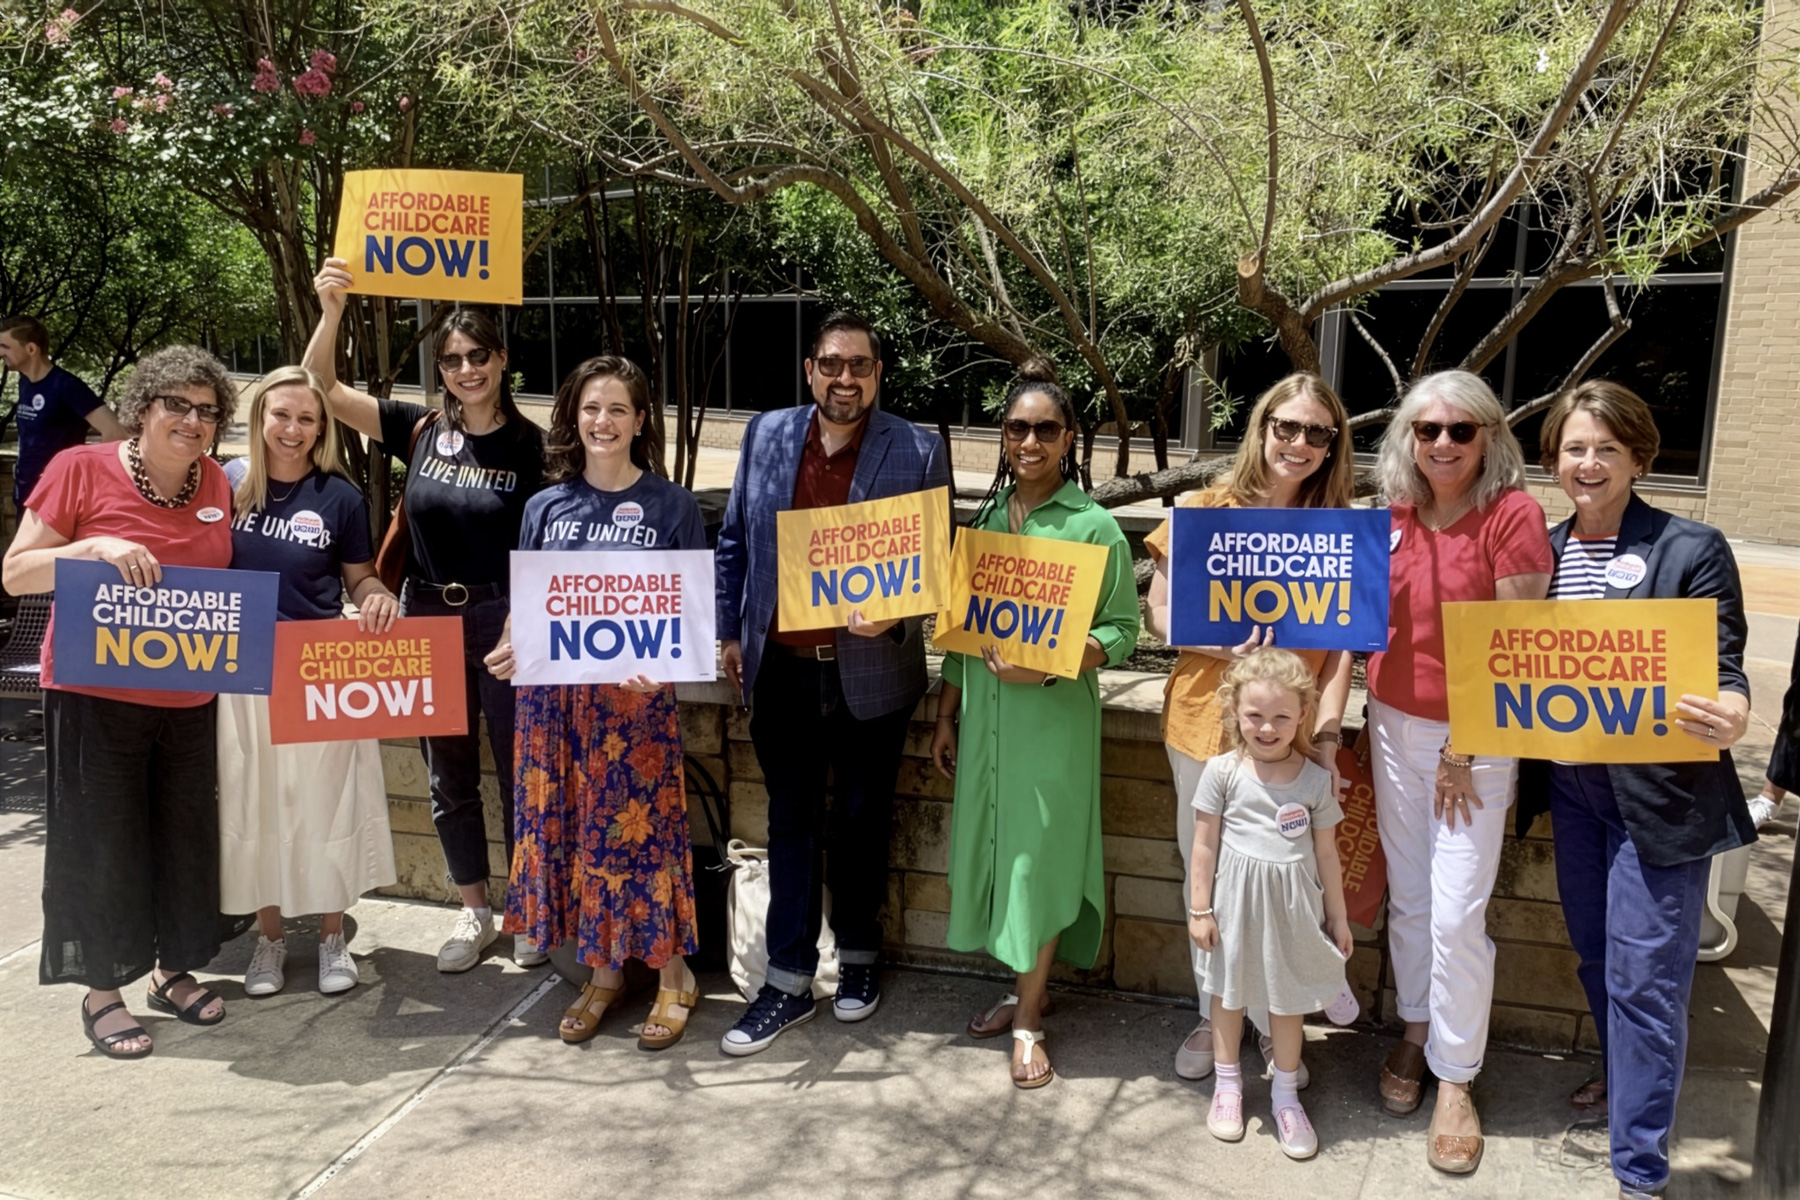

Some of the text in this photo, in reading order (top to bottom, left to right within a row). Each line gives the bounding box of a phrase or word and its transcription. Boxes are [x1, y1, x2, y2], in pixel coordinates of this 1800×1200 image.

[368, 192, 489, 212] AFFORDABLE
[364, 211, 489, 235] CHILDCARE
[365, 236, 489, 279] NOW!
[419, 456, 517, 492] LIVE UNITED
[543, 521, 657, 548] LIVE UNITED
[809, 514, 921, 547] AFFORDABLE
[1209, 533, 1353, 554] AFFORDABLE
[807, 535, 921, 566] CHILDCARE
[976, 552, 1076, 583] AFFORDABLE
[1206, 554, 1352, 578] CHILDCARE
[547, 574, 681, 593] AFFORDABLE
[811, 556, 921, 606] NOW!
[971, 572, 1071, 605] CHILDCARE
[95, 584, 241, 610] AFFORDABLE
[545, 595, 681, 615] CHILDCARE
[1209, 580, 1351, 626] NOW!
[92, 604, 239, 631] CHILDCARE
[963, 596, 1064, 649] NOW!
[96, 629, 238, 673] NOW!
[301, 640, 430, 660] AFFORDABLE
[550, 618, 681, 660] NOW!
[1489, 629, 1666, 653] AFFORDABLE
[300, 659, 431, 680] CHILDCARE
[1488, 654, 1666, 681] CHILDCARE
[305, 680, 434, 721] NOW!
[1495, 683, 1667, 735] NOW!
